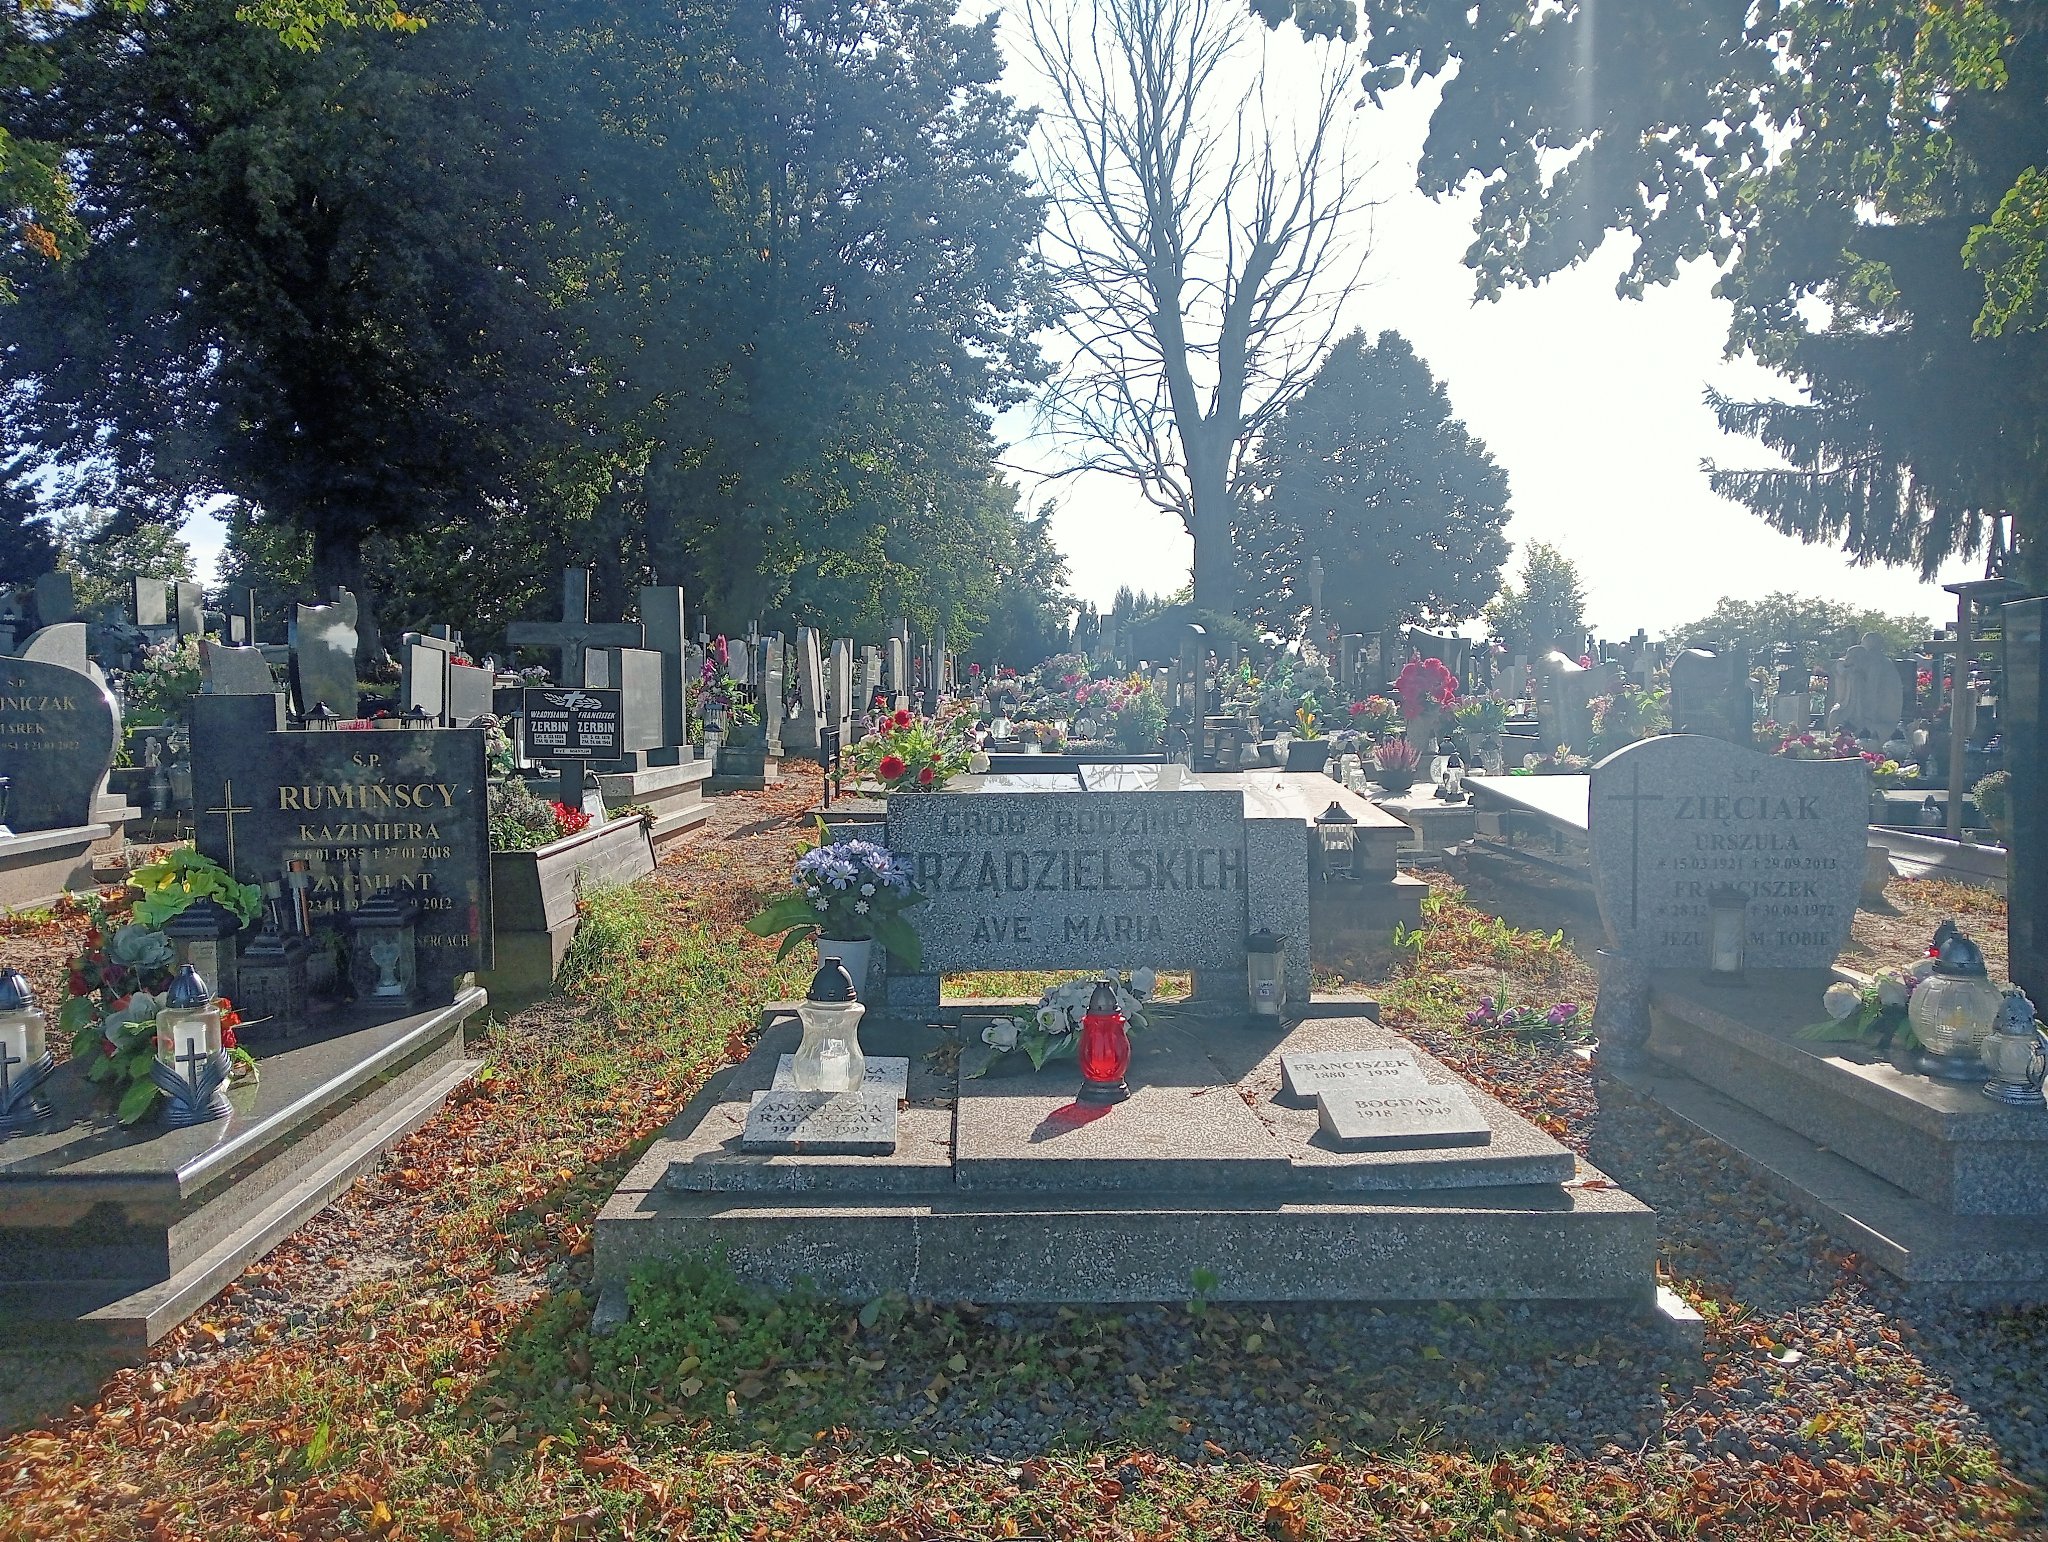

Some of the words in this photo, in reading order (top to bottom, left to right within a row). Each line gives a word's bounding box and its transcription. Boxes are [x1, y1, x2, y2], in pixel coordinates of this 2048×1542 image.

[577, 711, 616, 720] FRANCISZEK
[531, 721, 569, 732] ZERBIN
[577, 722, 615, 733] ZERBIN
[278, 777, 458, 811] RUMIŃSCY
[1674, 796, 1824, 827] ZIĘCIAK
[299, 823, 440, 842] KAZIMIERA
[1694, 833, 1800, 851] URSZULA
[972, 916, 1033, 943] AVE
[1064, 915, 1164, 943] MARIA
[1776, 930, 1831, 946] TOBIE
[1293, 1059, 1410, 1072] FRANCISZEK
[1368, 1069, 1399, 1077] 1939
[761, 1103, 882, 1112] ANASTAZJA
[1354, 1096, 1442, 1109] BOGDAN
[760, 1113, 882, 1123] RATAJCZAK
[1356, 1109, 1393, 1119] 1918
[1418, 1106, 1452, 1117] 1949
